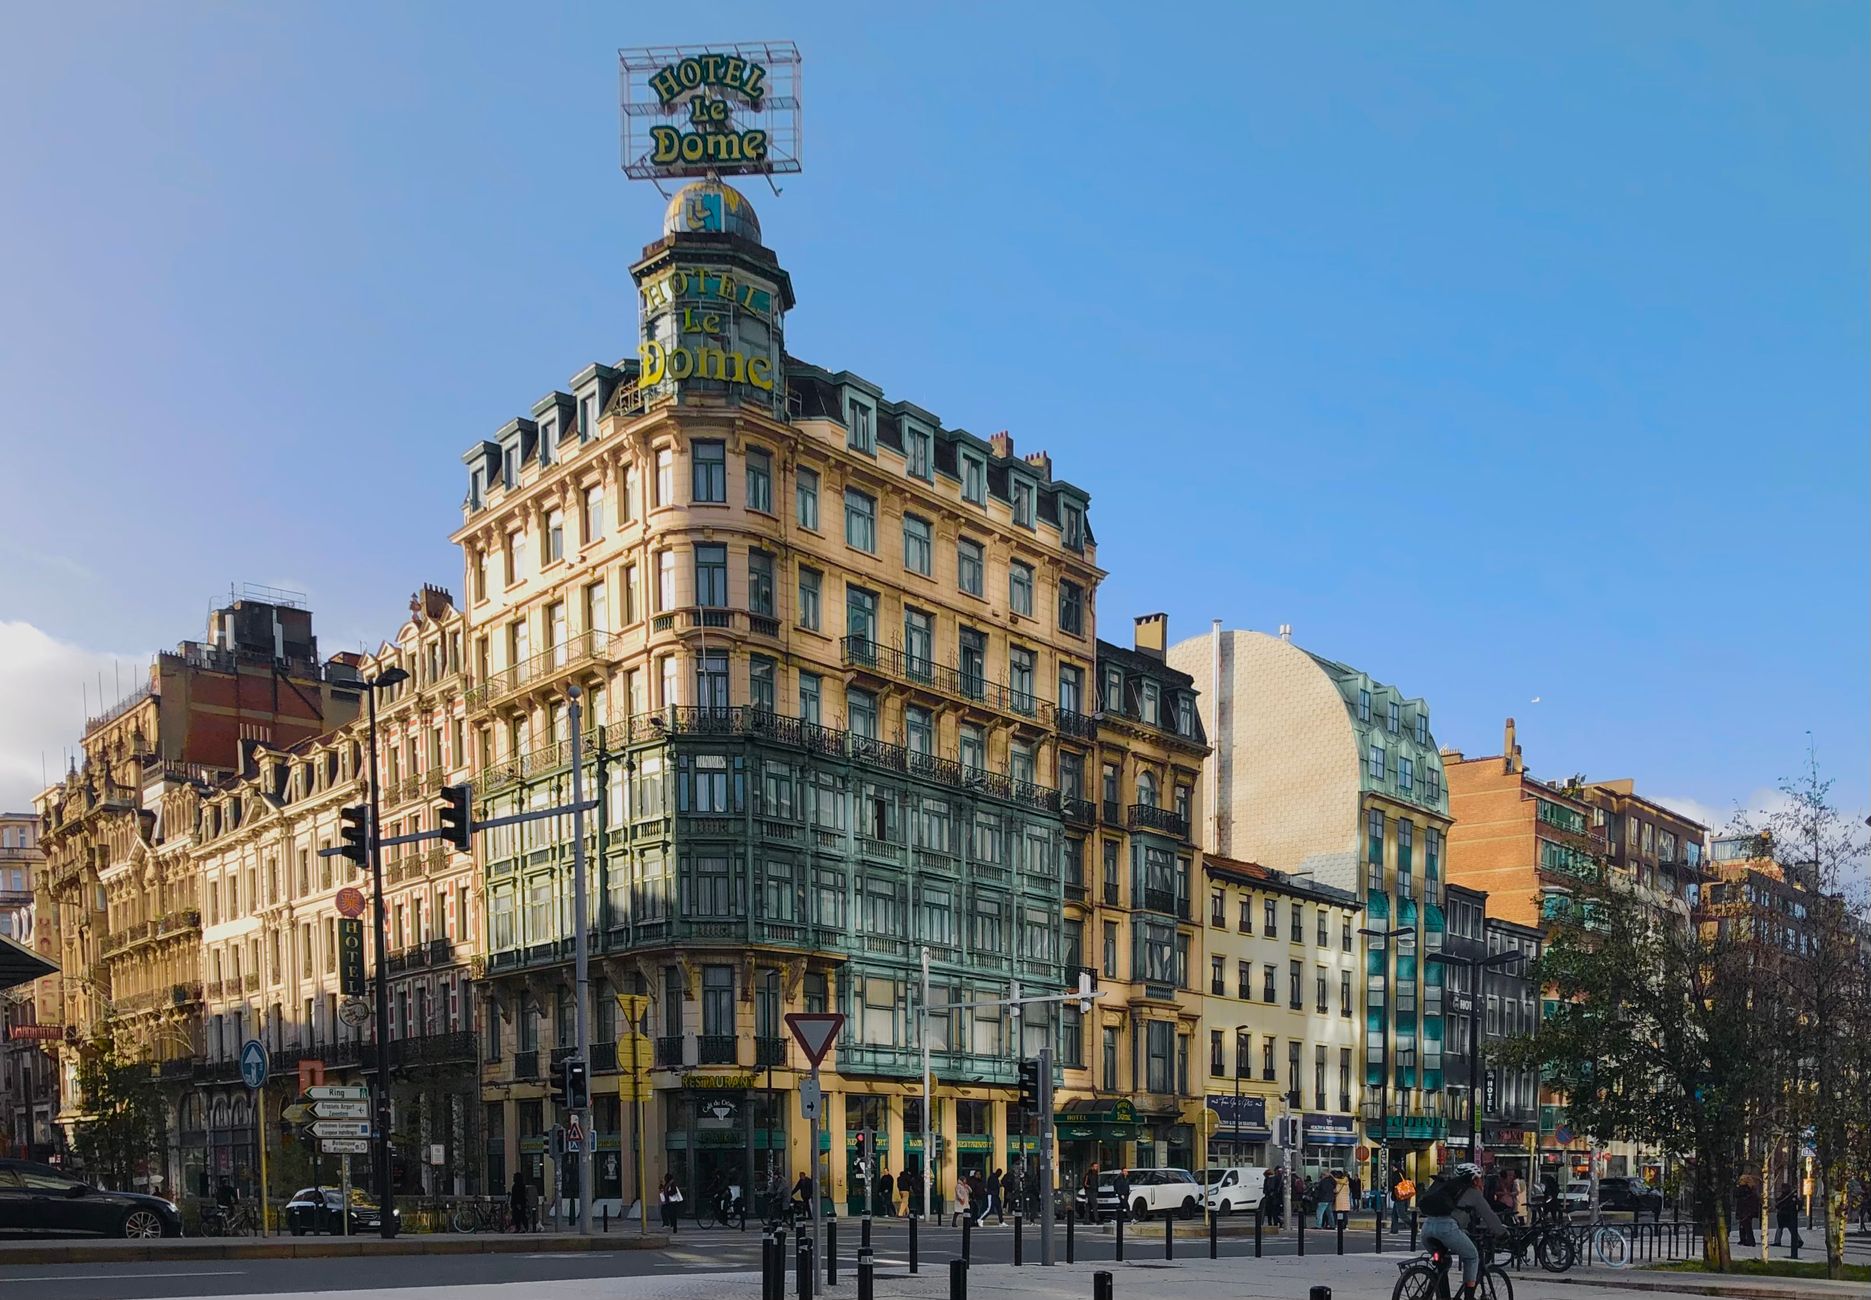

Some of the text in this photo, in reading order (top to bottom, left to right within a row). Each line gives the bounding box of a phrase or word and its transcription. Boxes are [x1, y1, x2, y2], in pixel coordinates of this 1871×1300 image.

[649, 55, 766, 103] HOTEL
[690, 97, 727, 121] Le
[651, 128, 766, 162] Dome
[642, 267, 765, 317] HOTEL
[683, 307, 721, 333] Le
[637, 341, 774, 391] Dome
[345, 921, 360, 993] HOTEL
[328, 1088, 345, 1099] Ring
[682, 1075, 756, 1089] RESTAURANT
[1486, 1080, 1495, 1113] HOTEL
